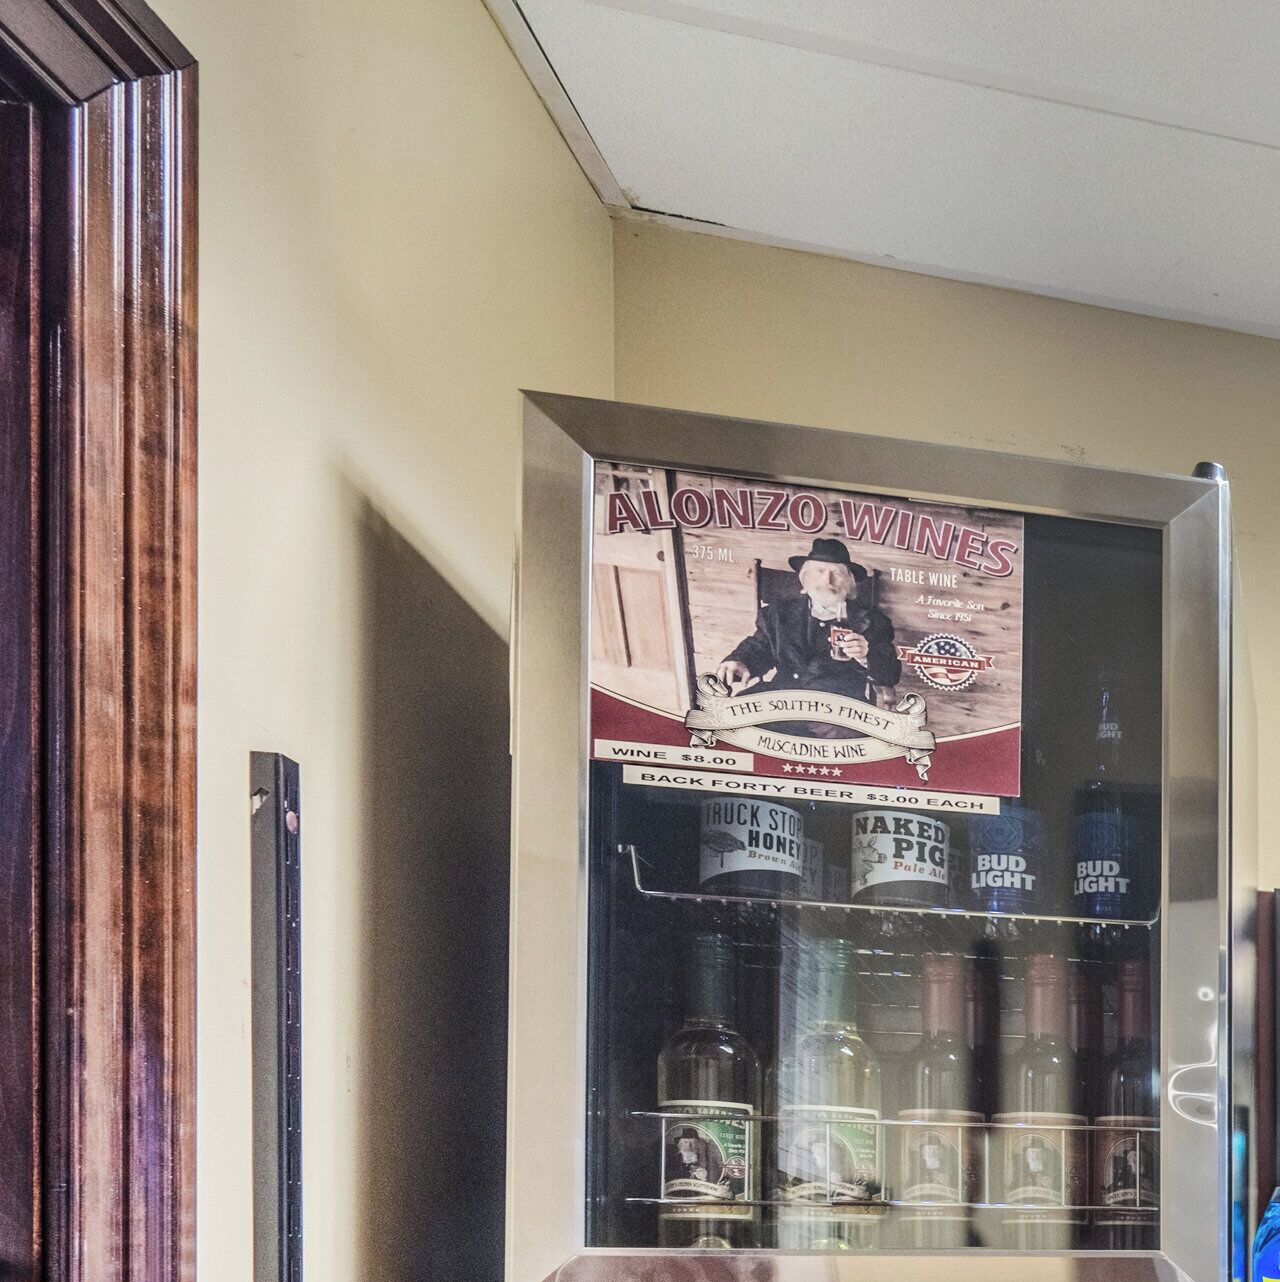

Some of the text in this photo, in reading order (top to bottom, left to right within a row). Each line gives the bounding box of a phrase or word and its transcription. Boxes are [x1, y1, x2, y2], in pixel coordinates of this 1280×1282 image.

[607, 488, 1019, 578] ALONZO WINES
[692, 544, 714, 561] 375
[890, 568, 958, 588] TABLE WINE
[928, 609, 973, 623] Since 1951
[913, 654, 979, 669] AMERICAN
[725, 699, 896, 733] THE SOUTH'S FINEST
[612, 747, 737, 766] WINE $8.00
[758, 734, 867, 759] MUSCADINE WINE
[641, 772, 985, 811] BACK FORTY BEER $3.00 EACH
[854, 815, 946, 846] NAKED
[747, 850, 787, 865] Brown
[892, 837, 946, 869] PIG
[977, 854, 1027, 872] BUD
[892, 860, 925, 874] Pale
[1076, 860, 1121, 878] BUD
[971, 871, 1036, 891] LIGHT
[1074, 876, 1130, 896] LIGHT
